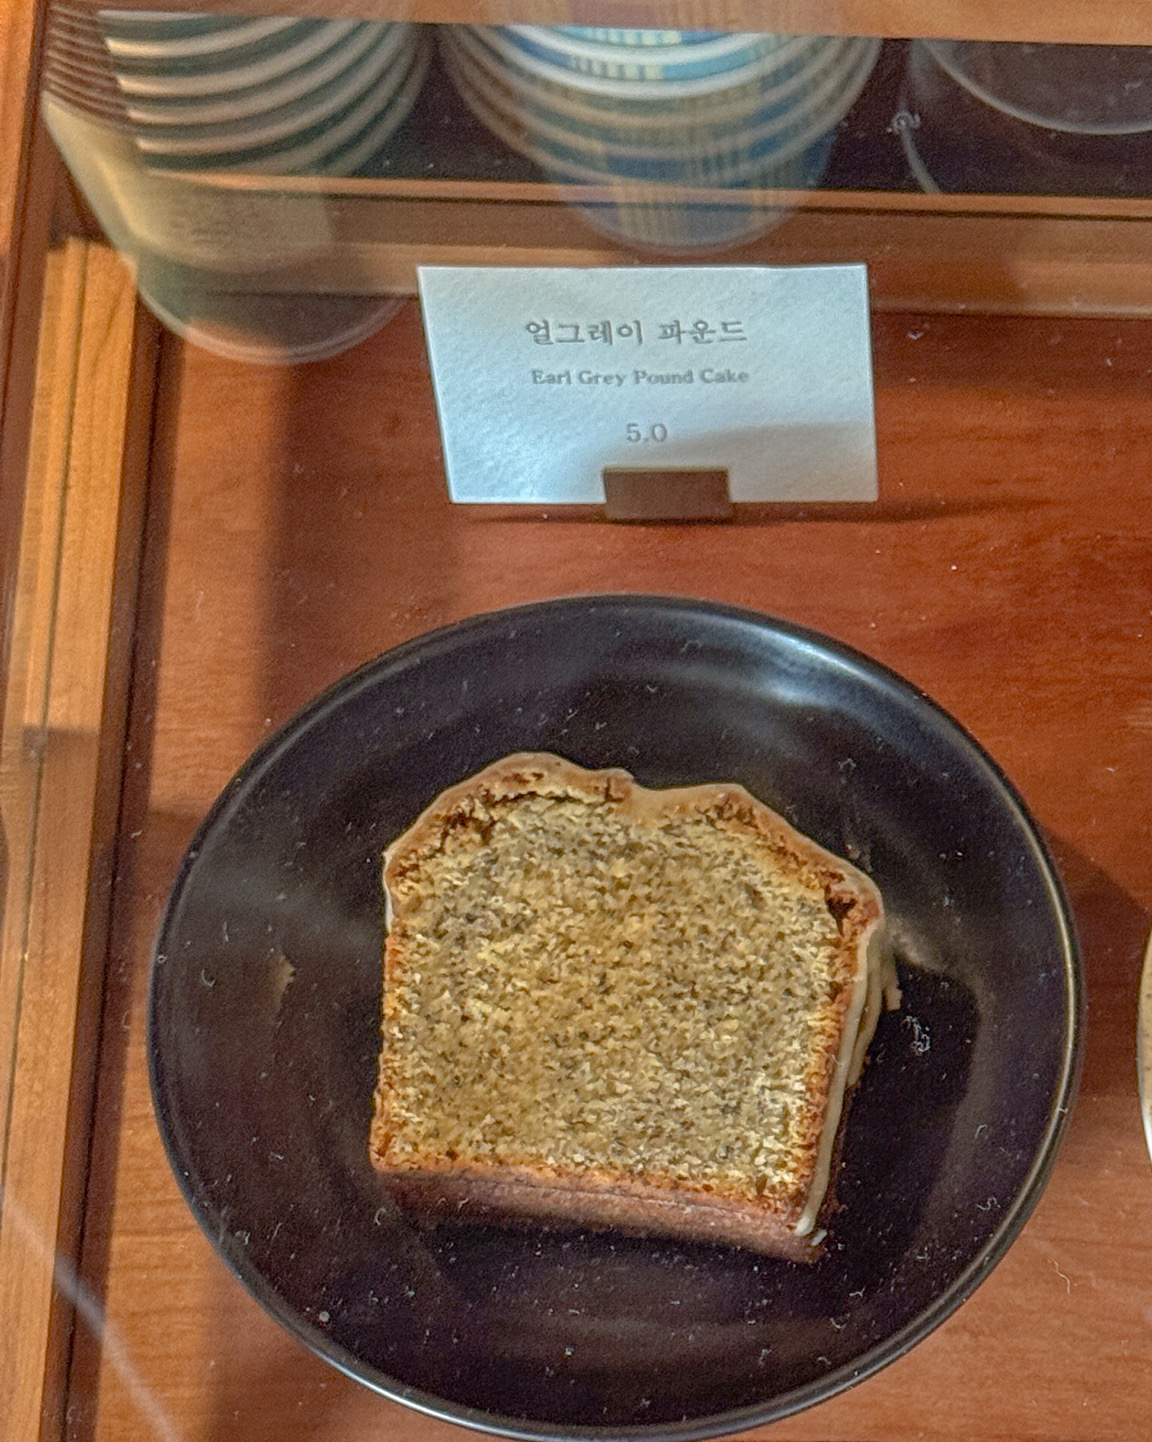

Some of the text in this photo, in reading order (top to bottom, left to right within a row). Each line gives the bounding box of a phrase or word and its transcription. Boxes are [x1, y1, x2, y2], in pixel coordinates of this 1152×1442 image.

[526, 319, 748, 346] 얼그레이 파운드
[531, 367, 749, 387] Earl Grey Pound Cake
[626, 422, 668, 443] 5.0
